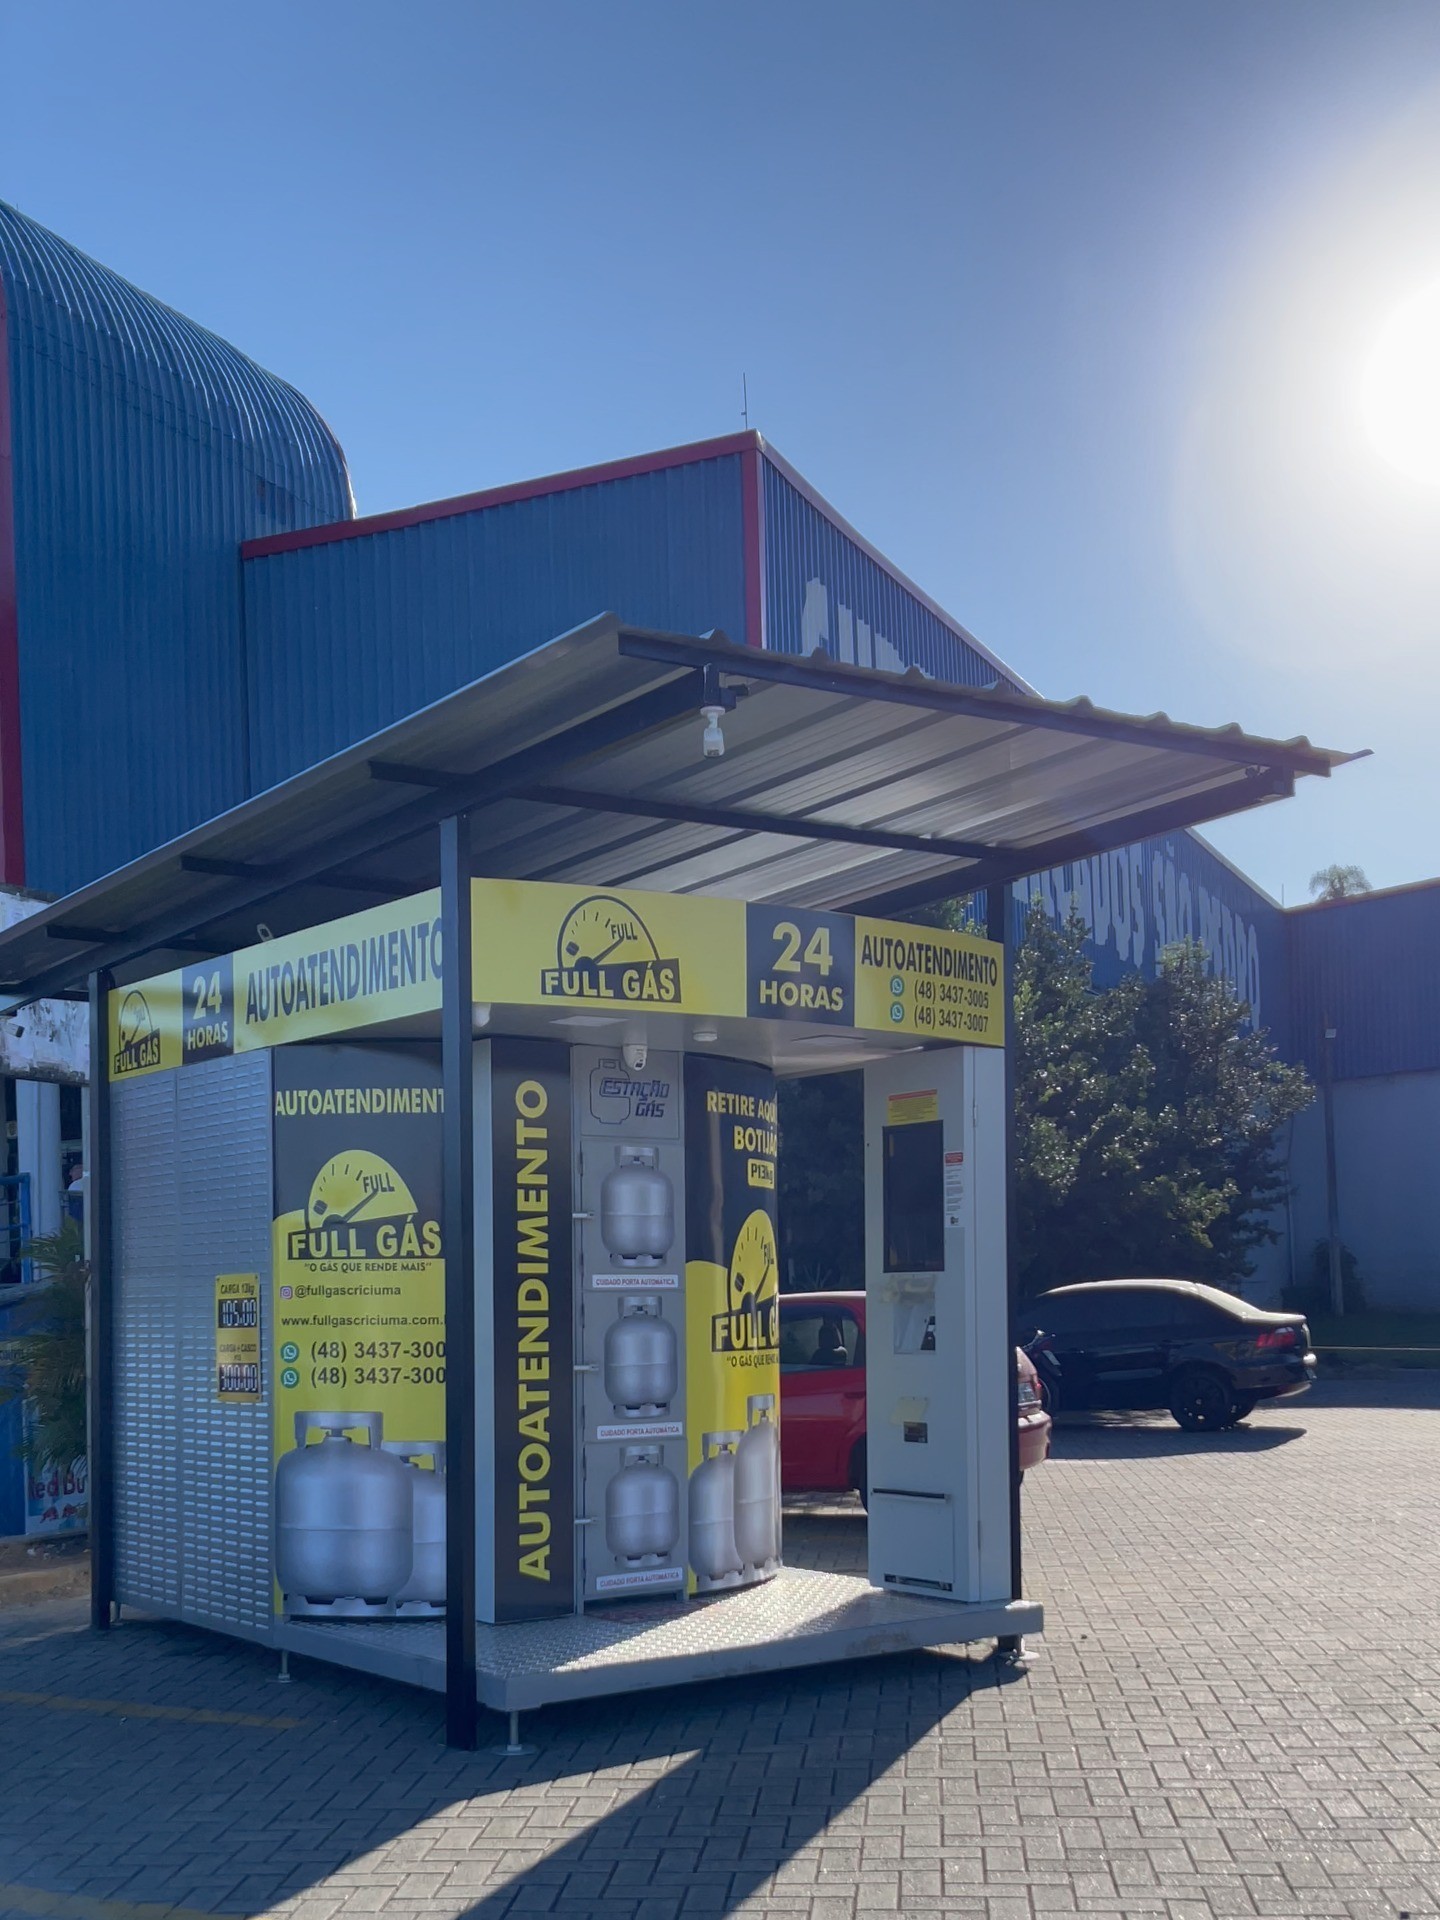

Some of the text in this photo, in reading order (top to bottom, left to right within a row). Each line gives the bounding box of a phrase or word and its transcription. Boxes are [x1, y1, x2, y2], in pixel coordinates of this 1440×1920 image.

[610, 921, 638, 941] FULL
[772, 921, 833, 976] 24
[861, 934, 998, 987] AUTOATENDIMENTO
[545, 961, 675, 1000] FULL GÁS
[192, 971, 223, 1020] 24
[759, 979, 844, 1012] HORAS
[914, 979, 989, 1009] (48) 3437-3005
[914, 1004, 989, 1033] (48) 3437-3007
[187, 1021, 228, 1050] HORAS
[115, 1048, 138, 1073] FULL
[602, 1079, 670, 1101] ESTAÇÃO
[635, 1100, 665, 1118] GÁS
[707, 1091, 755, 1118] RETIRE
[362, 1172, 396, 1193] FULL
[291, 1214, 442, 1259] FULL GÁS
[341, 1262, 361, 1273] QUE
[365, 1262, 398, 1272] RENDE
[295, 1285, 401, 1298] @fullgascriciuma
[596, 1278, 620, 1286] CUIDADO
[621, 1278, 639, 1286] PORTA
[281, 1314, 446, 1327] www.fullgascriciuma.com.
[514, 1079, 551, 1582] AUTOATENDIMENTO
[715, 1311, 766, 1350] FULL
[311, 1341, 347, 1363] (48)
[311, 1367, 347, 1388] (48)
[601, 1429, 625, 1437] CUIDADO
[627, 1427, 644, 1436] PORTA
